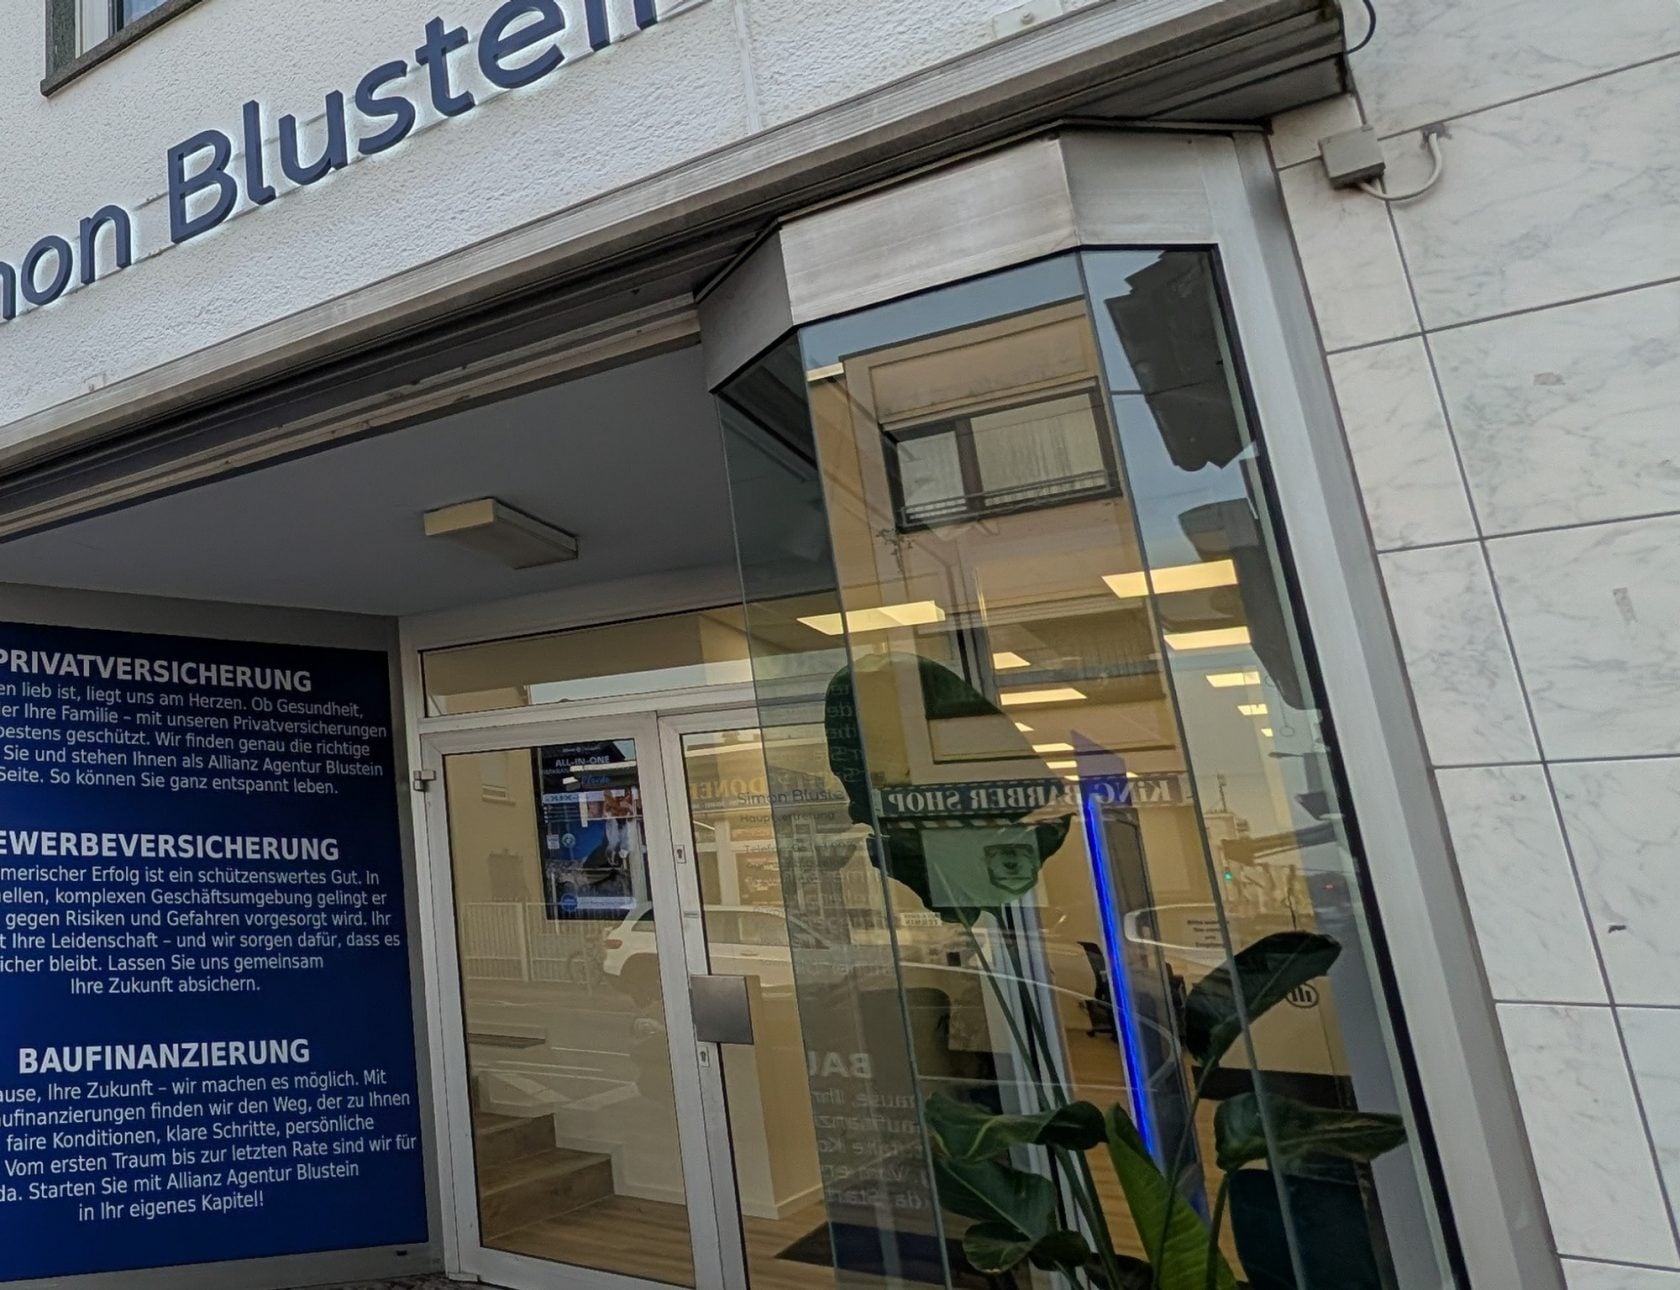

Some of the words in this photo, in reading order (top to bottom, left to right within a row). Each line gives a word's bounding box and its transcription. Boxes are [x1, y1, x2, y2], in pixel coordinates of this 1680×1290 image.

[167, 0, 658, 244] Bluste
[22, 682, 52, 698] lieb
[58, 684, 81, 702] ist,
[87, 685, 122, 705] liegt
[127, 692, 154, 705] uns
[159, 694, 183, 706] am
[189, 693, 247, 710] Herzen.
[251, 697, 273, 712] Ob
[277, 699, 363, 719] Gesundheit,
[25, 703, 56, 720] Ihre
[62, 705, 118, 723] Familie
[136, 711, 162, 725] mit
[167, 715, 228, 729] unseren
[233, 716, 386, 740] Privatversicherungen
[4, 745, 29, 761] Sie
[35, 747, 66, 763] und
[72, 749, 127, 765] stehen
[133, 751, 176, 767] Ihnen
[182, 753, 204, 768] als
[208, 755, 258, 771] Allianz
[263, 757, 322, 775] Agentur
[326, 760, 383, 776] Blustein
[555, 755, 610, 767] ALL-IN-ONE
[50, 768, 70, 784] So
[76, 769, 136, 786] können
[141, 772, 165, 787] Sie
[170, 776, 207, 791] ganz
[212, 776, 289, 794] entspannt
[294, 778, 338, 794] leben.
[92, 866, 139, 886] Erfolg
[145, 866, 164, 882] ist
[169, 867, 193, 882] ein
[198, 867, 326, 884] schützenswertes
[331, 869, 362, 885] Gut.
[366, 870, 379, 885] In
[56, 887, 146, 907] komplexen
[151, 888, 312, 908] Geschäftsumgebung
[317, 890, 368, 908] gelingt
[372, 894, 387, 905] er
[13, 933, 45, 948] Ihre
[52, 932, 158, 948] Leidenschaft
[177, 932, 206, 948] und
[211, 932, 236, 947] wir
[240, 935, 292, 951] sorgen
[298, 931, 341, 948] dafür,
[347, 932, 380, 946] dass
[384, 934, 400, 946] es
[50, 954, 102, 971] bleibt.
[108, 955, 165, 971] Lassen
[171, 954, 195, 970] Sie
[201, 957, 229, 970] uns
[234, 953, 323, 973] gemeinsam
[71, 978, 103, 994] Ihre
[109, 976, 173, 993] Zukunft
[178, 976, 260, 992] absichern.
[19, 1039, 309, 1074] BAUFINANZIERUNG
[49, 1083, 81, 1100] Ihre
[87, 1079, 153, 1098] Zukunft
[172, 1077, 197, 1095] wir
[202, 1075, 266, 1093] machen
[271, 1076, 289, 1089] es
[294, 1070, 359, 1091] möglich.
[364, 1069, 387, 1085] Mit
[151, 1101, 203, 1119] finden
[209, 1099, 233, 1116] wir
[238, 1098, 268, 1114] den
[273, 1096, 312, 1115] Weg,
[317, 1094, 343, 1110] der
[347, 1096, 364, 1108] zu
[369, 1091, 410, 1107] Ihnen
[6, 1134, 46, 1152] faire
[53, 1129, 160, 1149] Konditionen,
[167, 1124, 207, 1142] klare
[213, 1120, 280, 1139] Schritte,
[286, 1114, 374, 1138] persönliche
[4, 1159, 44, 1176] Vom
[50, 1155, 107, 1173] ersten
[111, 1152, 166, 1169] Traum
[172, 1148, 195, 1165] bis
[201, 1149, 227, 1163] zur
[232, 1144, 287, 1161] letzten
[292, 1141, 328, 1157] Rate
[333, 1137, 364, 1154] sind
[369, 1135, 392, 1151] wir
[395, 1134, 416, 1150] für
[79, 1203, 94, 1221] in
[101, 1201, 124, 1219] Ihr
[130, 1199, 196, 1220] eigenes
[202, 1190, 263, 1213] Kapitel!
